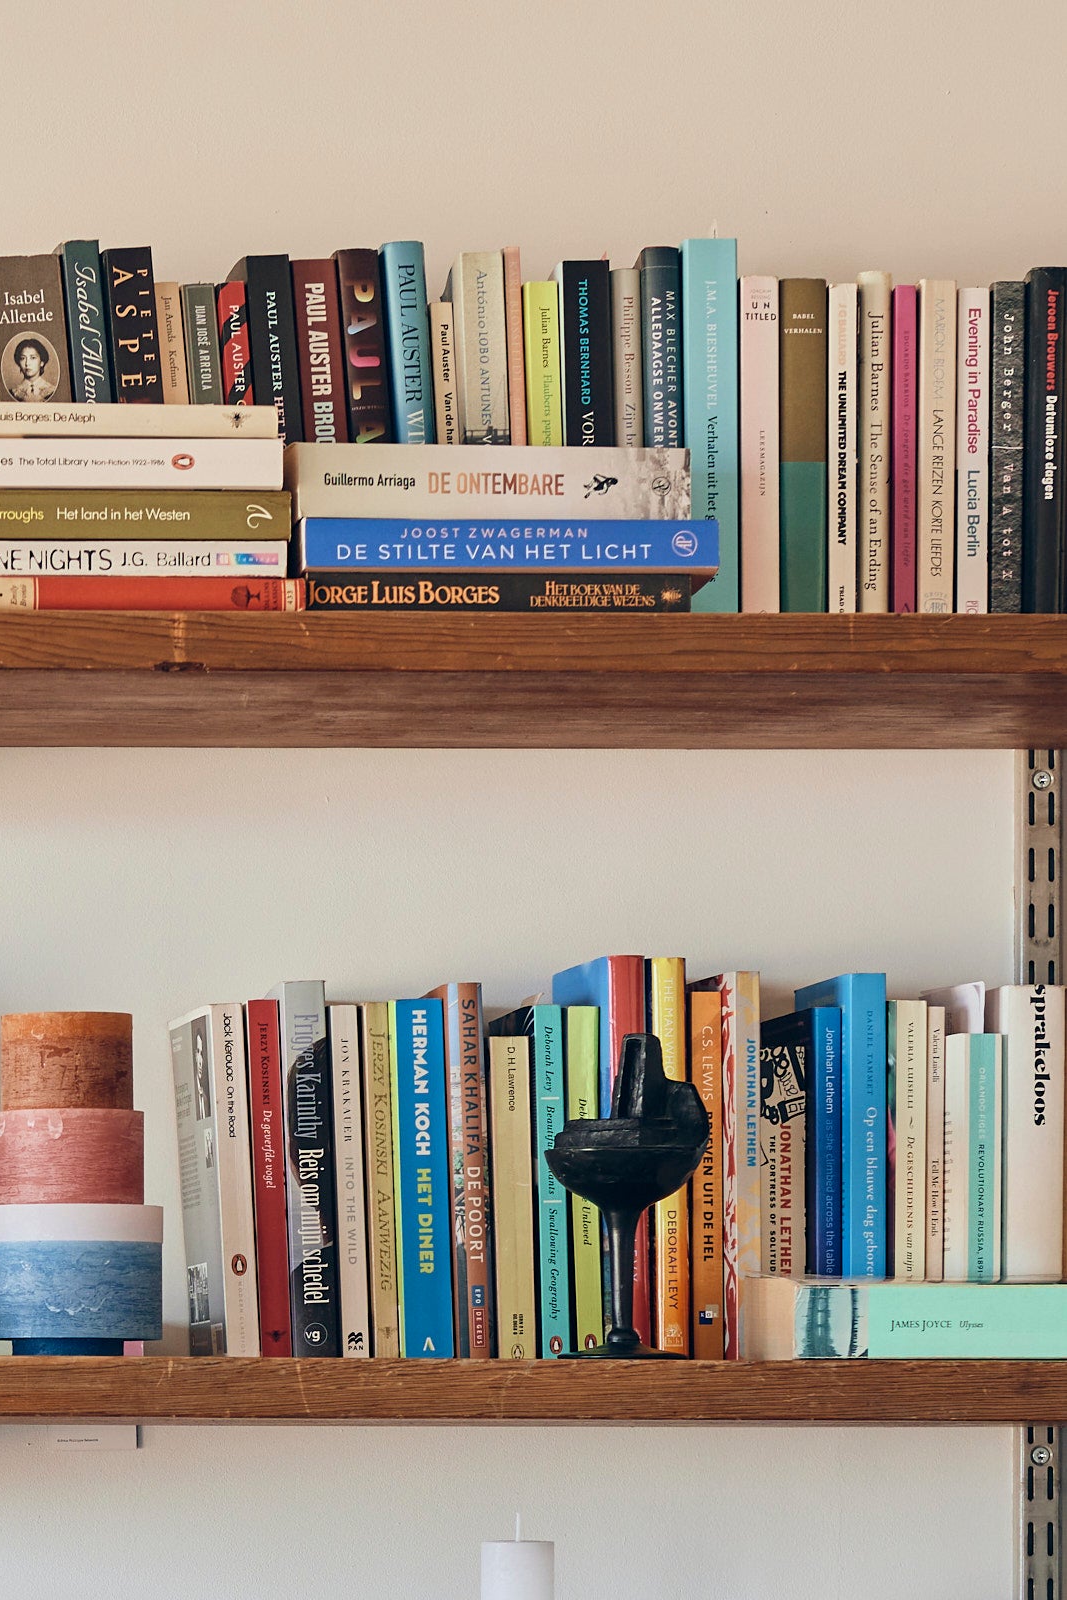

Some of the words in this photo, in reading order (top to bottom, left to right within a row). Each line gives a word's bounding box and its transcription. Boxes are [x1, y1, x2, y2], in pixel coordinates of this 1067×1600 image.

[4, 289, 45, 306] Isabel
[74, 262, 101, 338] Isabel
[266, 291, 278, 329] PAUL
[305, 283, 327, 326] PAUL
[398, 264, 417, 317] PAUL
[578, 279, 590, 335] THOMAS
[665, 291, 676, 320] MAX
[1047, 289, 1059, 331] Jeroen
[0, 308, 54, 325] Allende
[137, 268, 157, 386] PIETER
[229, 304, 242, 339] PAUL
[440, 324, 449, 346] Paul
[539, 307, 551, 334] Julian
[745, 312, 777, 321] TITLED
[783, 327, 823, 335] VERHALEN
[868, 312, 884, 358] Julian
[542, 337, 551, 368] Barnes
[651, 297, 662, 386] ALLEDAAGSE
[965, 308, 981, 367] Evening
[232, 342, 246, 393] AUSTER
[269, 333, 283, 391] AUSTER
[308, 330, 332, 396] AUSTER
[401, 323, 423, 404] AUSTER
[442, 347, 451, 383] Auster
[580, 337, 591, 405] BERNHARD
[666, 328, 677, 392] BLECHER
[968, 371, 981, 384] in
[1046, 332, 1059, 391] Brouwers
[443, 392, 452, 409] Van
[543, 375, 553, 417] Flauberts
[870, 363, 884, 411] Barnes
[445, 411, 453, 421] de
[870, 420, 883, 449] The
[967, 388, 981, 454] Paradise
[1045, 395, 1058, 461] Datumloze
[324, 472, 374, 486] Guillermo
[377, 473, 416, 490] Arriaga
[428, 472, 451, 494] DE
[456, 472, 565, 496] ONTEMBARE
[869, 454, 882, 494] Sense
[967, 470, 980, 510] Lucia
[1041, 462, 1057, 500] dagen
[56, 507, 78, 520] Het
[81, 507, 107, 521] land
[110, 508, 121, 521] in
[124, 507, 143, 521] het
[145, 508, 190, 521] Westen
[869, 500, 881, 515] of
[869, 517, 877, 535] an
[337, 544, 368, 560] DE
[379, 544, 456, 560] STILTE
[466, 544, 514, 560] VAN
[525, 544, 571, 560] HET
[582, 544, 652, 560] LICHT
[400, 528, 460, 539] JOOST
[469, 528, 588, 538] ZWAGERMAN
[967, 514, 980, 557] Berlin
[29, 549, 113, 571] NIGHTS
[121, 552, 148, 567] J.G.
[156, 552, 211, 567] Ballard
[864, 539, 882, 591] Ending
[308, 580, 368, 607] JORGE
[371, 581, 416, 604] LUIS
[418, 581, 500, 604] BORGES
[223, 1013, 233, 1037] Jack
[462, 999, 477, 1066] SAHAR
[702, 1026, 713, 1050] C.S.
[866, 1010, 874, 1047] DANIEL
[225, 1040, 234, 1082] Kerouac
[340, 1038, 349, 1063] JON
[369, 1028, 385, 1088] JERZY
[411, 1009, 429, 1094] HERMAN
[544, 1026, 554, 1067] Deborah
[1029, 983, 1052, 1127] sprakeloos
[544, 1068, 554, 1093] Levy
[702, 1056, 714, 1101] LEWIS
[746, 1038, 756, 1108] JONATHAN
[866, 1053, 874, 1095] TAMMET
[227, 1087, 235, 1100] On
[227, 1100, 235, 1114] the
[342, 1070, 352, 1142] KRAKAUER
[229, 1116, 237, 1138] Road
[414, 1103, 431, 1156] KOCH
[464, 1072, 480, 1156] KHALIFA
[863, 1107, 878, 1127] Op
[374, 1094, 388, 1176] KOSINSKI
[746, 1114, 757, 1167] LETHEM
[866, 1133, 874, 1152] een
[344, 1157, 355, 1190] INTO
[467, 1166, 481, 1191] DE
[780, 1123, 792, 1209] JONATHAN
[866, 1157, 878, 1201] blauwe
[417, 1168, 433, 1207] HET
[703, 1182, 714, 1206] UIT
[346, 1197, 356, 1222] THE
[581, 1207, 592, 1246] Unloved
[703, 1211, 714, 1230] DE
[863, 1205, 878, 1227] dag
[347, 1228, 357, 1265] WILD
[377, 1190, 393, 1291] AANWEZIG
[418, 1213, 435, 1274] DINER
[468, 1197, 484, 1263] POORT
[547, 1208, 559, 1265] Swallowing
[667, 1210, 677, 1270] DEBORAH
[703, 1235, 714, 1262] HEL
[548, 1269, 560, 1321] Geography
[668, 1279, 678, 1310] LEVY
[891, 1320, 920, 1332] JAMES
[922, 1320, 952, 1332] JOYCE
[959, 1320, 984, 1330] Ulysses
